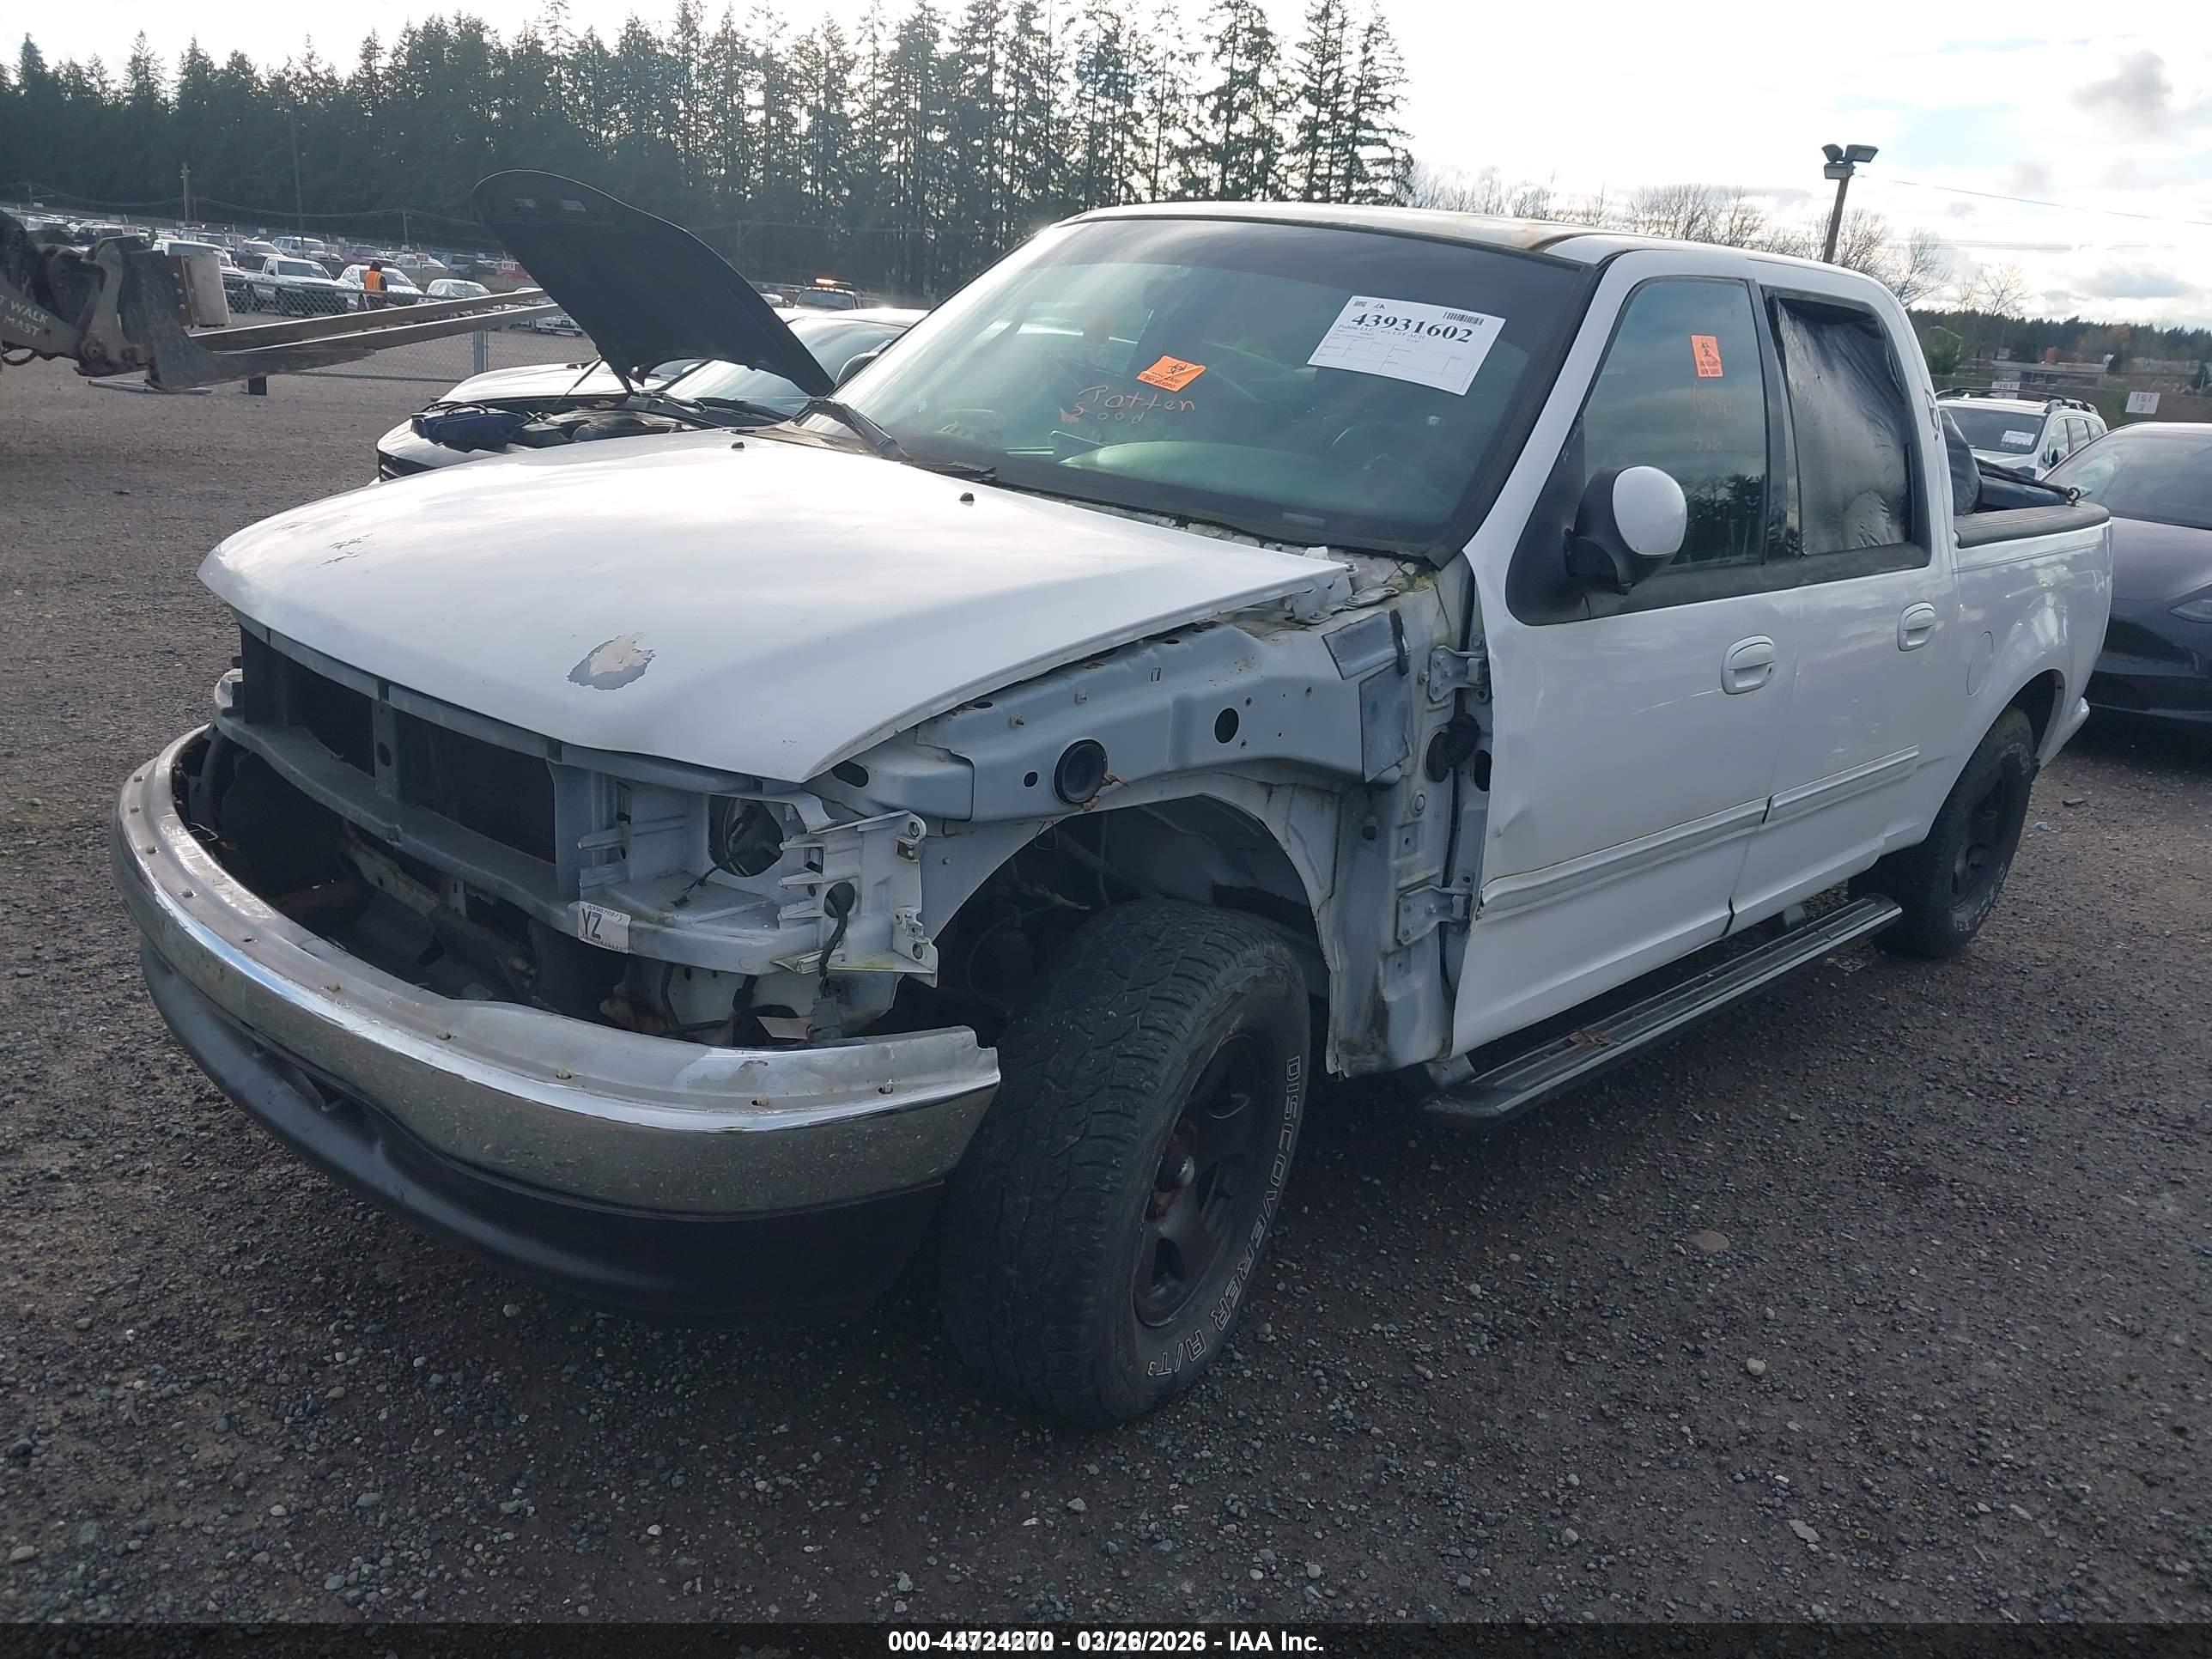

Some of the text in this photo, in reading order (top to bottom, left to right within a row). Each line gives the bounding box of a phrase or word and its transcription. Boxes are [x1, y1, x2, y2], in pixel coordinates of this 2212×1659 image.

[3, 314, 41, 337] MAST
[10, 301, 49, 325] WALK
[1352, 312, 1474, 343] 43931602
[581, 908, 603, 940] YZ
[1210, 1055, 1301, 1333] DISCOVERER
